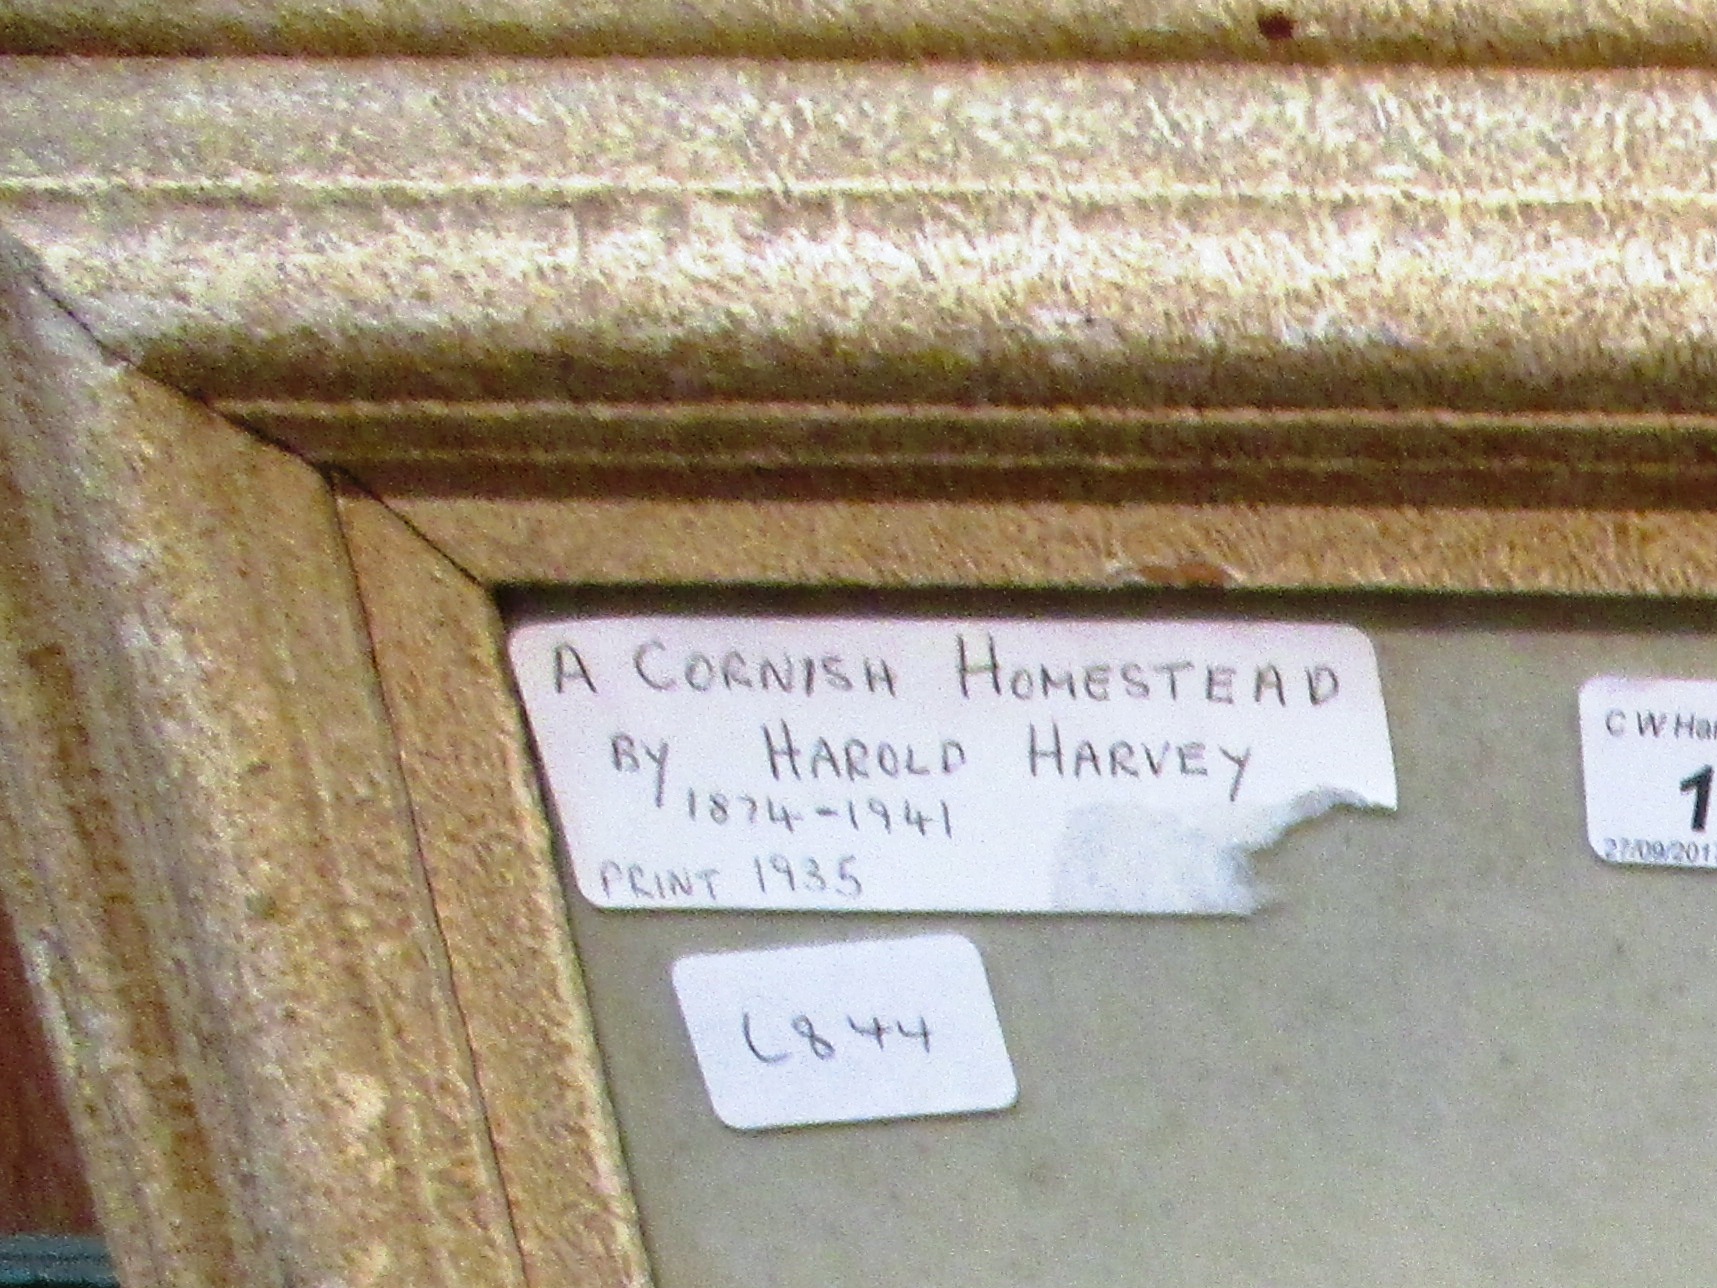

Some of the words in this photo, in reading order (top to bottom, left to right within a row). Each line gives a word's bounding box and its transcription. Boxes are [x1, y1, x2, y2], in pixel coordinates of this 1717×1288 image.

[553, 643, 597, 696] A
[633, 637, 898, 698] CORNISH
[957, 634, 1340, 707] HOMESTEAD
[1605, 709, 1626, 737] C
[1636, 711, 1667, 739] W
[611, 732, 670, 807] BY
[767, 720, 968, 782] HAROLD
[1028, 722, 1253, 804] HARVEY
[600, 859, 719, 901] PRINT
[754, 855, 864, 897] 1935
